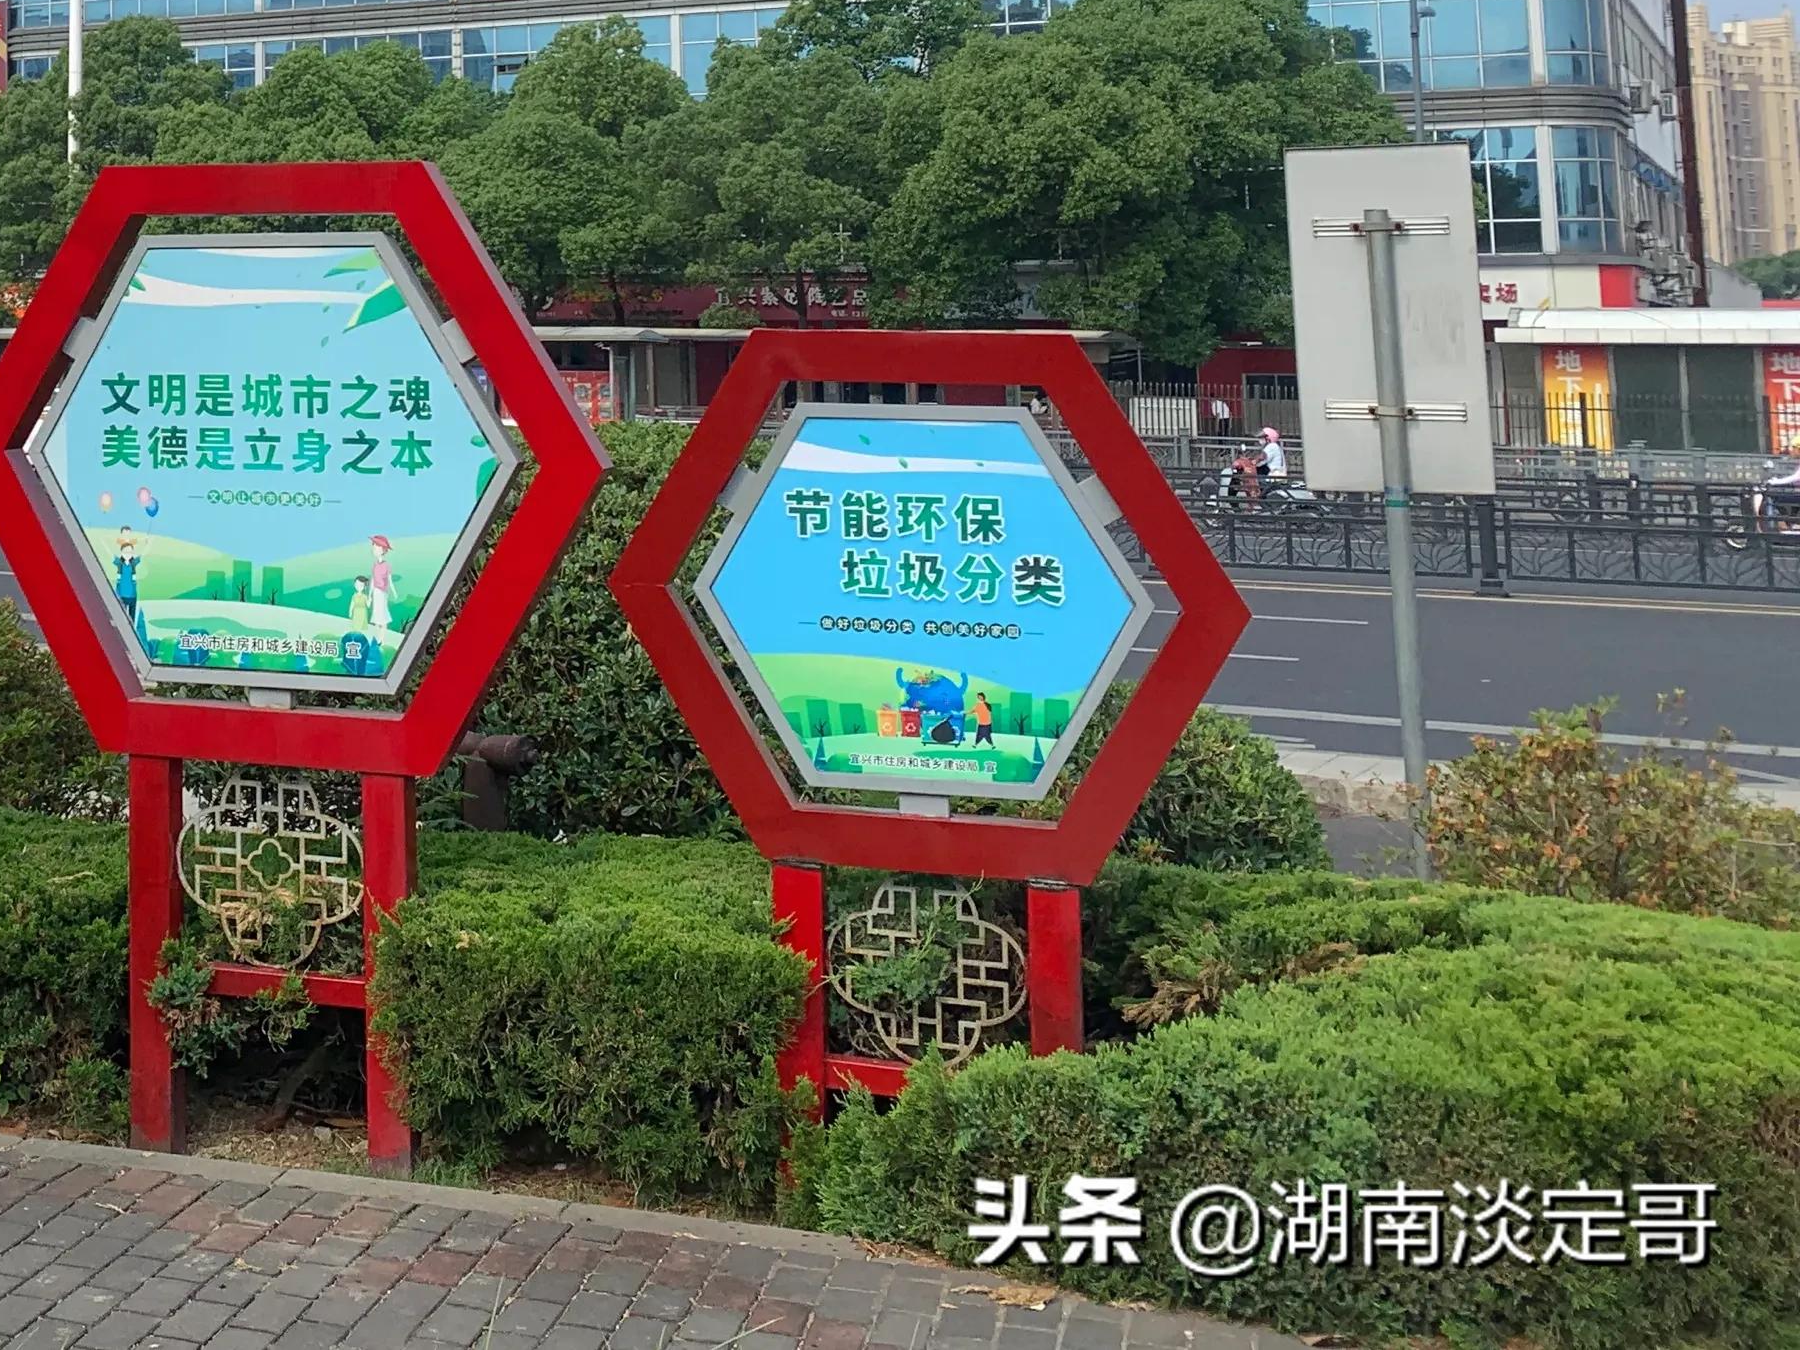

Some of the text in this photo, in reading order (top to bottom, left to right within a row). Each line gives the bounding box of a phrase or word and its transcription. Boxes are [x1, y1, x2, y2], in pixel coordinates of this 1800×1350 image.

[101, 372, 433, 421] 文明是城市之魂
[101, 424, 434, 477] 美德是立身之本
[207, 489, 322, 507] 文明让城市更美好
[785, 490, 1005, 544] 节能环保
[841, 549, 1066, 605] 垃圾分类
[820, 615, 1021, 639] 做好垃圾分类 共创美好家园
[178, 633, 361, 659] 宜兴市住房和城乡建设局 宣
[849, 753, 996, 774] 宜兴市住房和城乡建设局 宣
